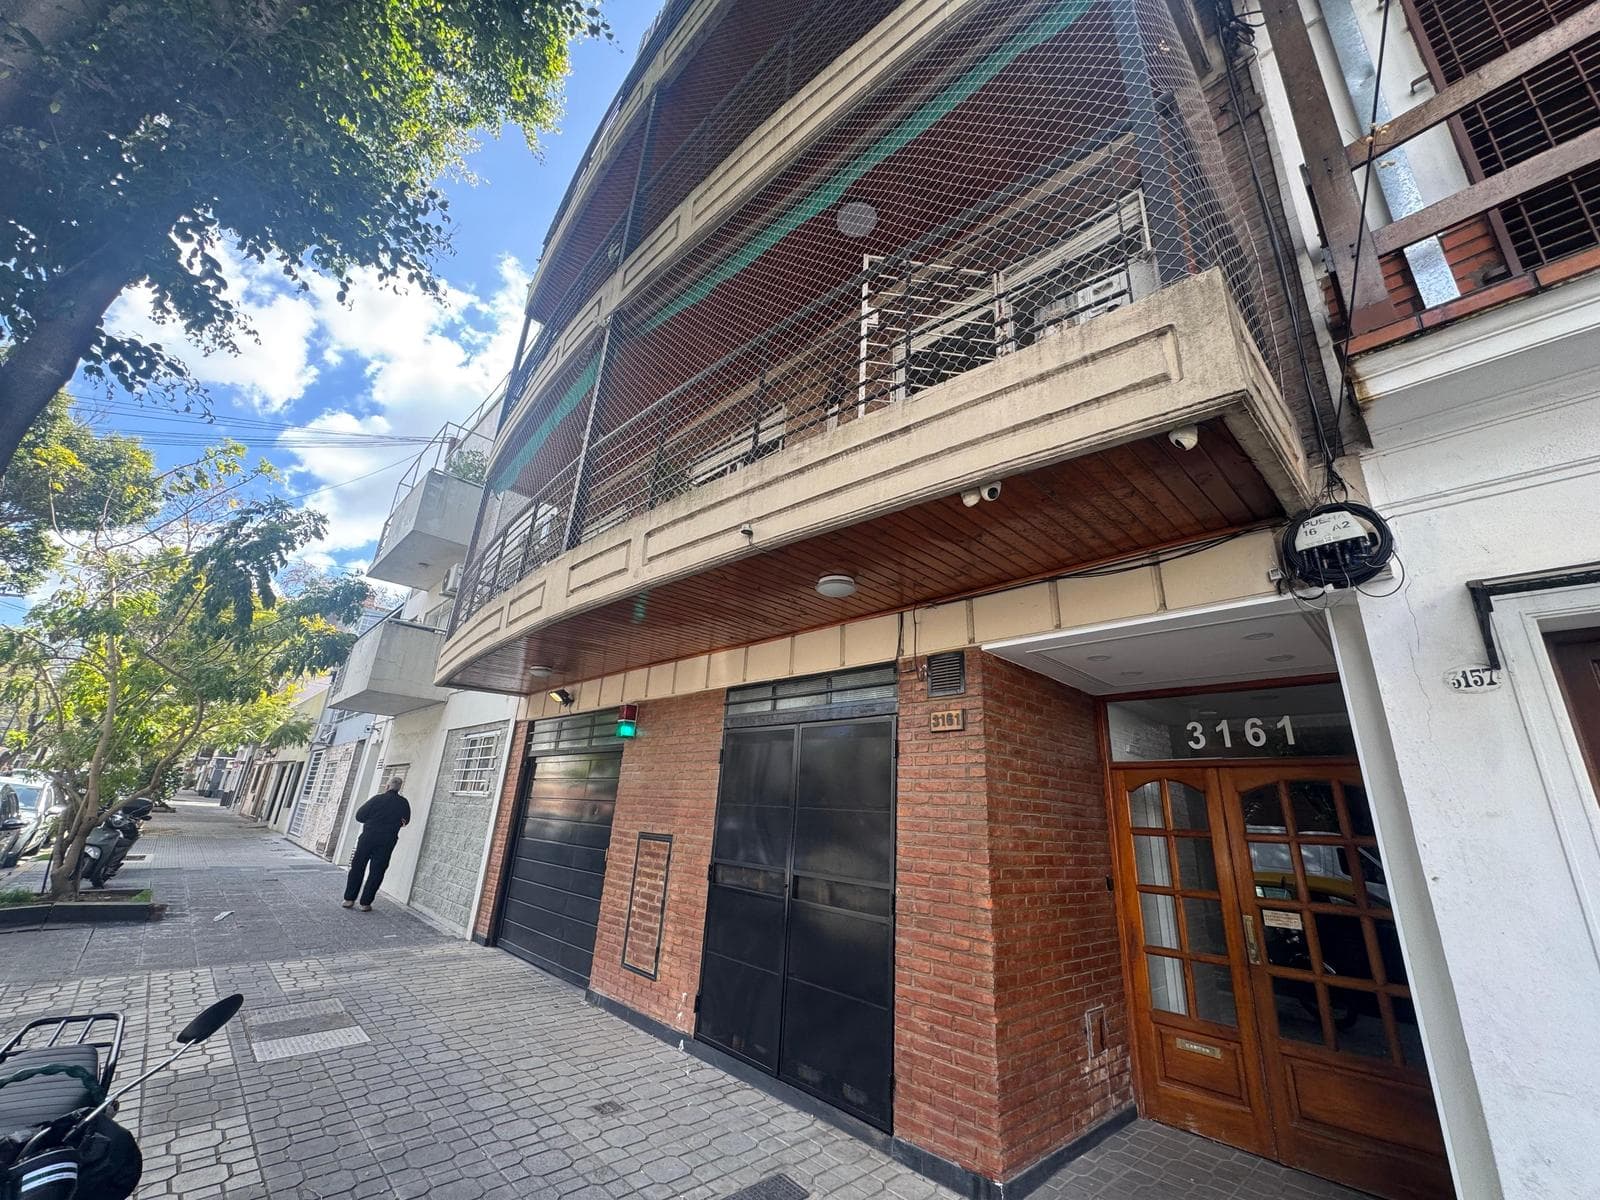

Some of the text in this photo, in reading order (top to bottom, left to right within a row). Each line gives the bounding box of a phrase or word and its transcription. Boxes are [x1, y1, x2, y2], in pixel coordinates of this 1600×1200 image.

[1303, 520, 1351, 537] 16 A2
[931, 712, 961, 728] 3161
[1186, 715, 1296, 750] 3161
